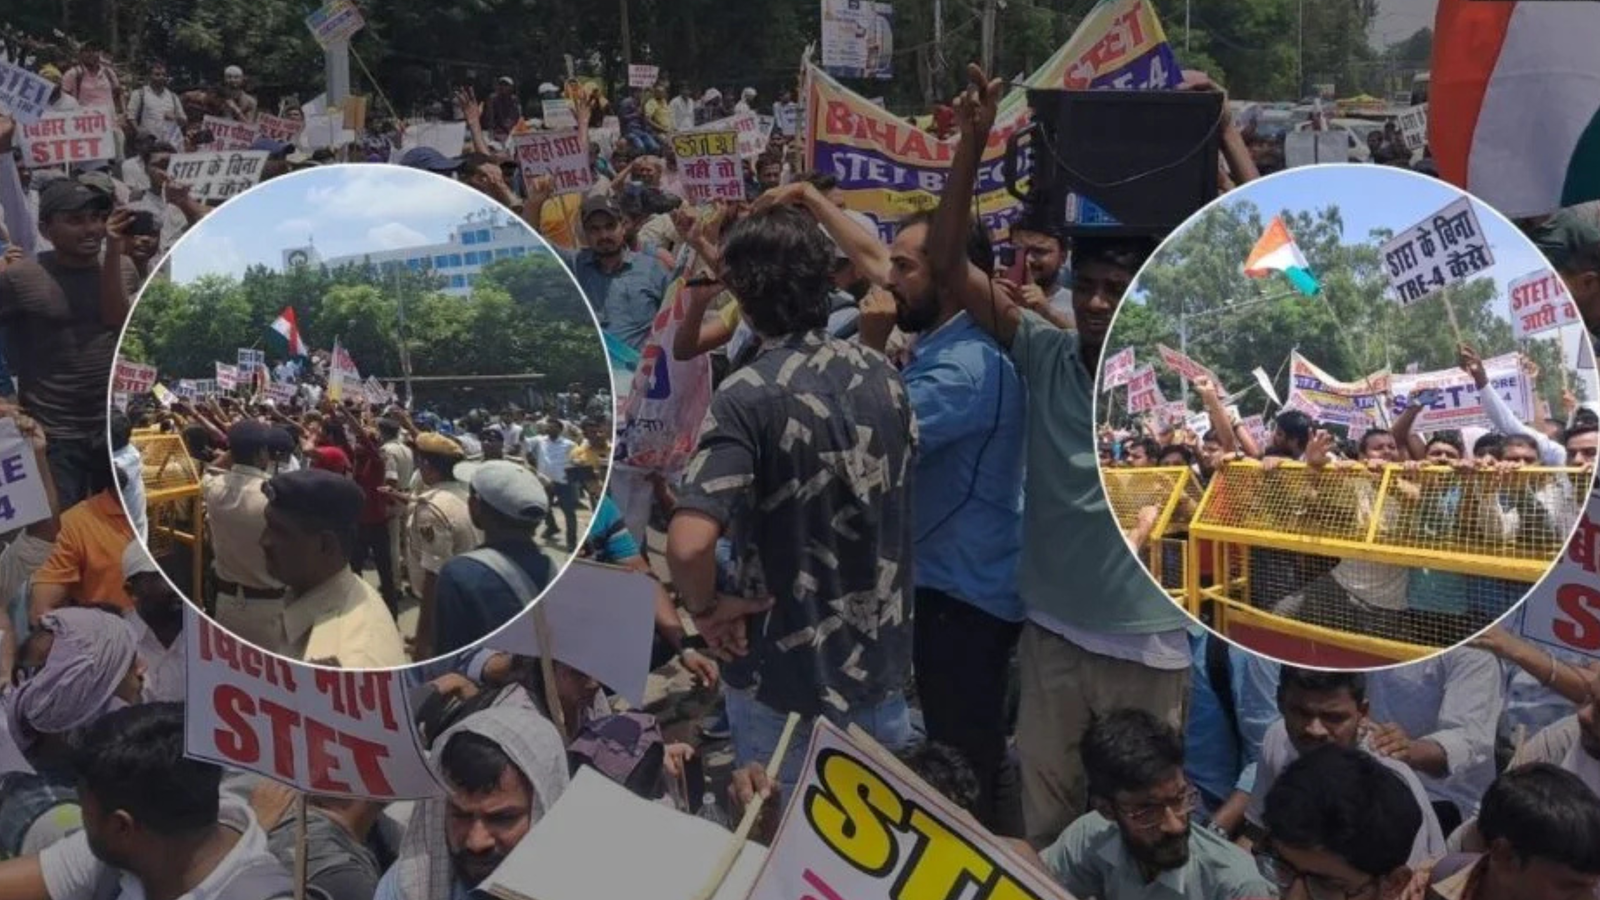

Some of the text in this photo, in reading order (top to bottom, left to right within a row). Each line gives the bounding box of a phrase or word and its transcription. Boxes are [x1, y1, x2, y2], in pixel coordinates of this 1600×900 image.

[30, 138, 103, 163] STET
[673, 131, 739, 157] STET
[172, 159, 204, 179] STET
[226, 153, 262, 176] बिना
[832, 151, 908, 184] STET
[1386, 210, 1476, 278] STET के बिना
[1396, 243, 1490, 304] TRE-4 कैसे
[1512, 277, 1549, 312] STET
[1520, 304, 1557, 332] जारी
[1393, 384, 1464, 415] SET
[212, 683, 396, 797] STET
